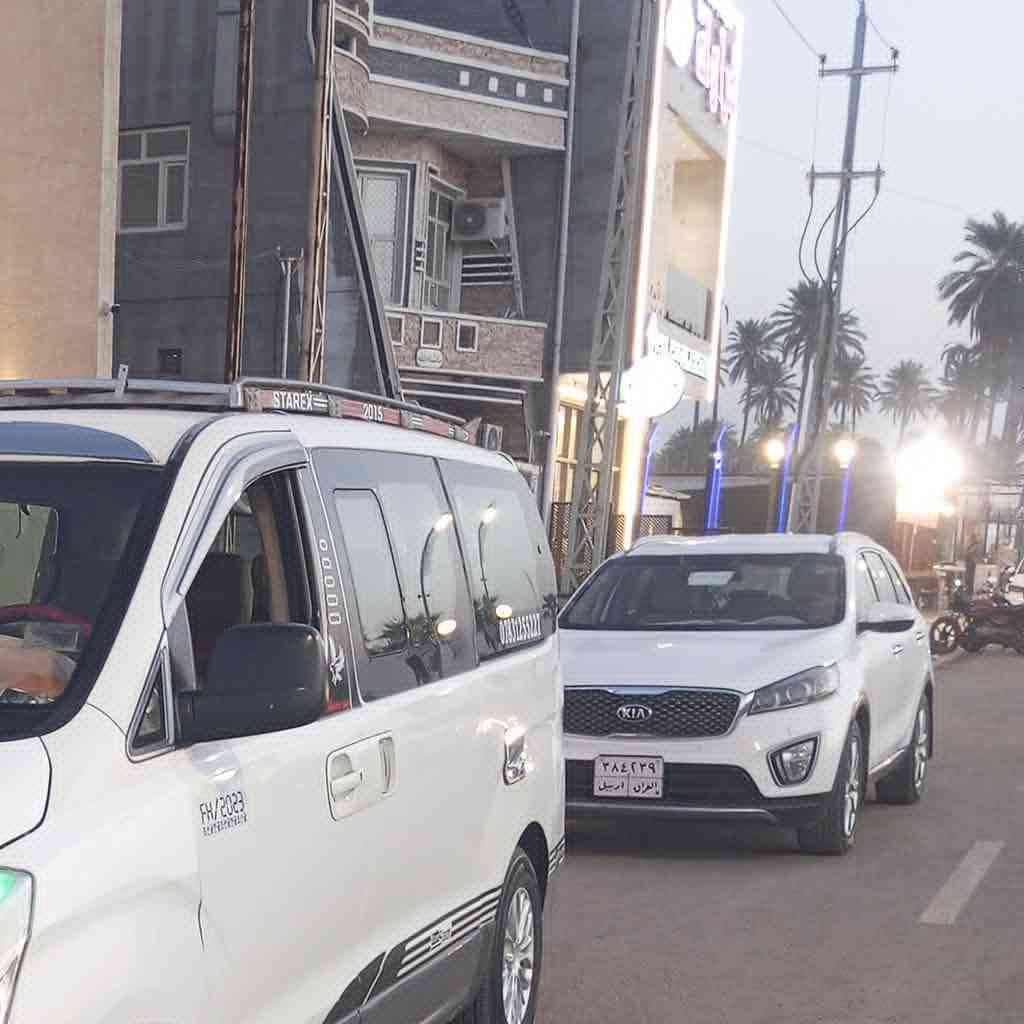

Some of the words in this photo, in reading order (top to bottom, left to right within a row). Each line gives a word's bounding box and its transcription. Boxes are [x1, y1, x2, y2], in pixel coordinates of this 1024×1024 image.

[272, 391, 313, 410] STAREX
[362, 403, 383, 421] 2015
[621, 707, 646, 719] KIA
